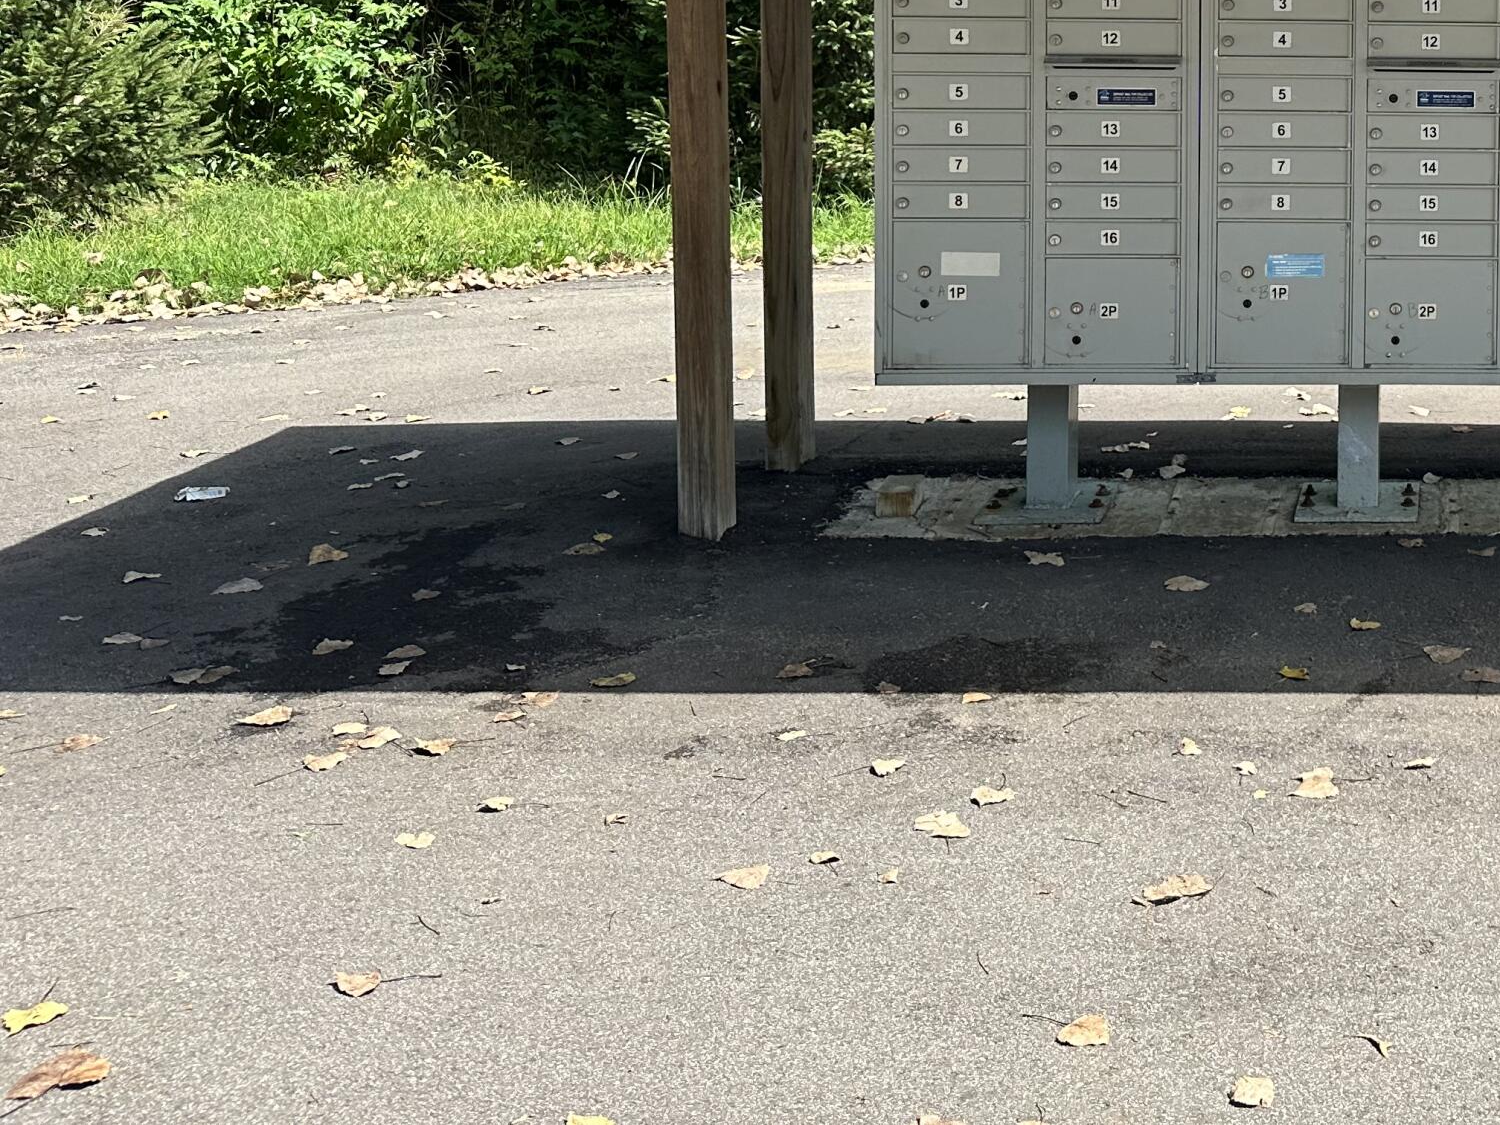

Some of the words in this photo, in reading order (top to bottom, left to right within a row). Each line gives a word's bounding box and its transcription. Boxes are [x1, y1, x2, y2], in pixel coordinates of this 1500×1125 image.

[1424, 0, 1438, 12] 11
[954, 30, 964, 43] 4
[1102, 32, 1119, 45] 12
[1277, 33, 1287, 46] 4
[1423, 35, 1438, 48] 12
[955, 85, 964, 98] 5
[1278, 88, 1287, 101] 5
[954, 122, 963, 135] 6
[1103, 123, 1118, 136] 13
[1277, 124, 1286, 137] 6
[1422, 126, 1437, 139] 13
[954, 158, 963, 171] 7
[1103, 159, 1119, 172] 14
[1277, 160, 1286, 172] 7
[1422, 161, 1437, 174] 14
[954, 194, 963, 207] 8
[1102, 195, 1118, 208] 15
[1276, 196, 1285, 209] 8
[1421, 197, 1436, 210] 15
[1102, 232, 1118, 244] 16
[1420, 233, 1436, 245] 16
[949, 286, 966, 299] 1P
[1271, 287, 1287, 300] 1P
[1100, 305, 1117, 317] 2P
[1419, 305, 1436, 318] 2P
